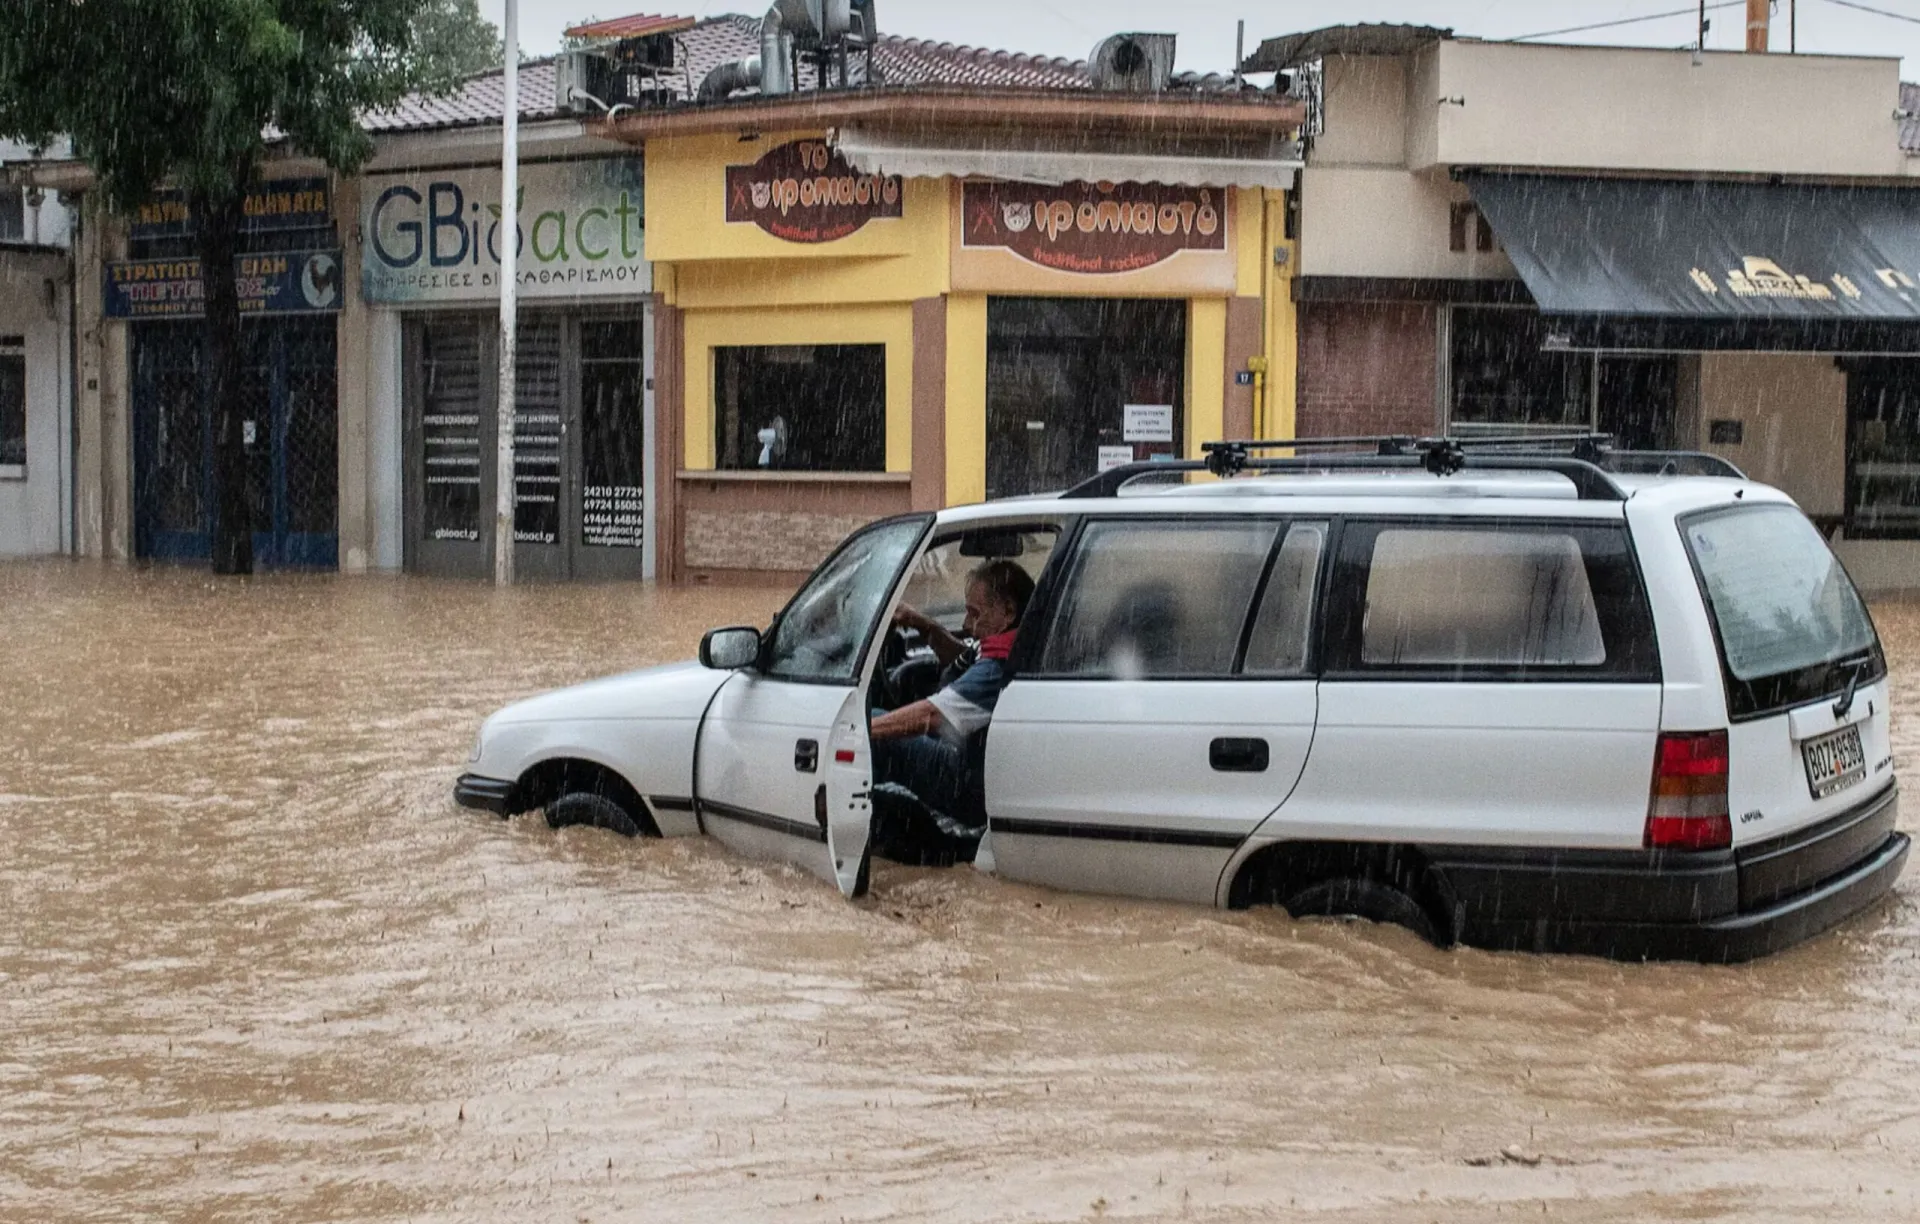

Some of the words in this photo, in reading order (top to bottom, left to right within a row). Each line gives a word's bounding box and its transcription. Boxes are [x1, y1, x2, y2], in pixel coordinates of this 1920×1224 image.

[112, 261, 200, 281] ΣΤΡΑΤΙΩΤ
[482, 265, 640, 287] ΒΙΚΑΘΑΡΙΣΜΟΥ
[1240, 372, 1249, 384] 17
[584, 486, 612, 498] 24210
[614, 486, 643, 498] 27729
[584, 499, 612, 511] 69724
[584, 513, 612, 525] 69464
[435, 527, 479, 540] gbioact.gr
[514, 529, 555, 543] bioact.gr
[584, 526, 643, 537] www.gbioact.gr
